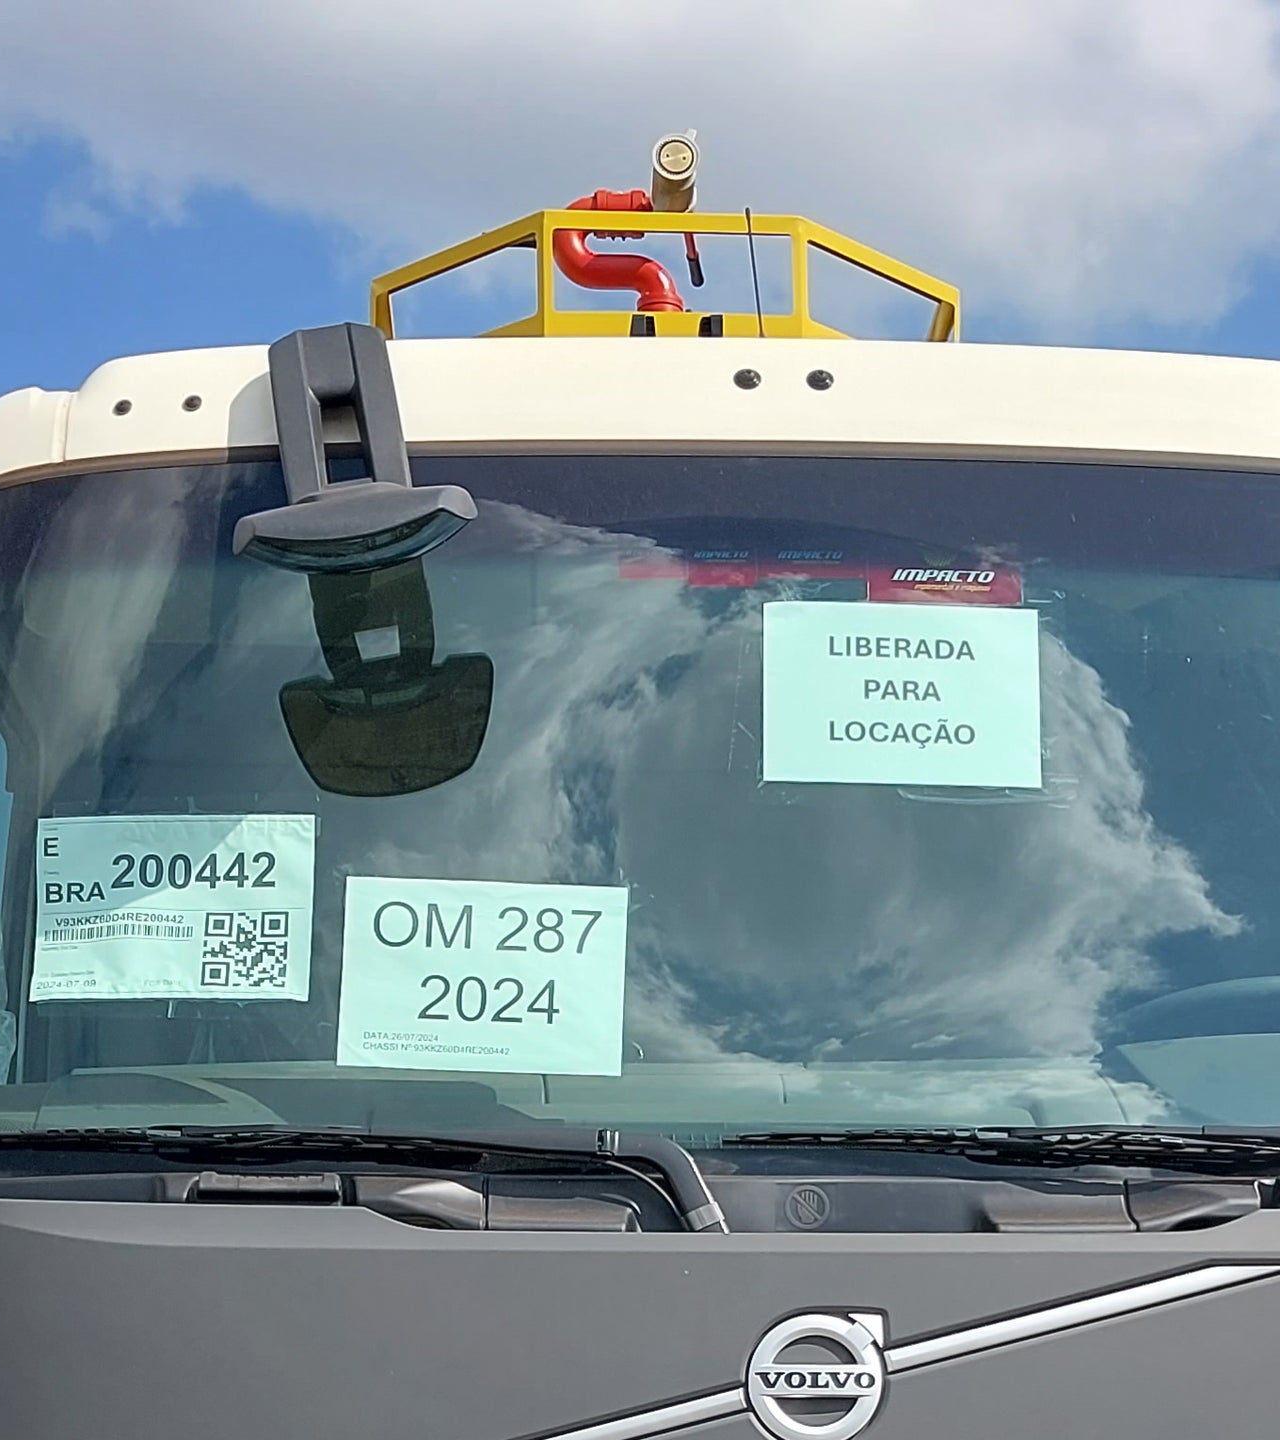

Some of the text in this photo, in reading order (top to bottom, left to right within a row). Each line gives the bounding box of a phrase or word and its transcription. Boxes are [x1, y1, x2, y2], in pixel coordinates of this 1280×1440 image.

[891, 568, 995, 583] IMPACTO
[829, 636, 975, 661] LIBERADA
[864, 679, 941, 702] PARA
[829, 718, 976, 749] LOCAÇÃO
[44, 837, 59, 857] E
[111, 851, 276, 890] 200442
[45, 882, 106, 904] BRA
[373, 901, 602, 954] OM 287
[417, 974, 560, 1025] 2024
[362, 1042, 399, 1051] CHASSI
[754, 1372, 876, 1389] VOLVO
